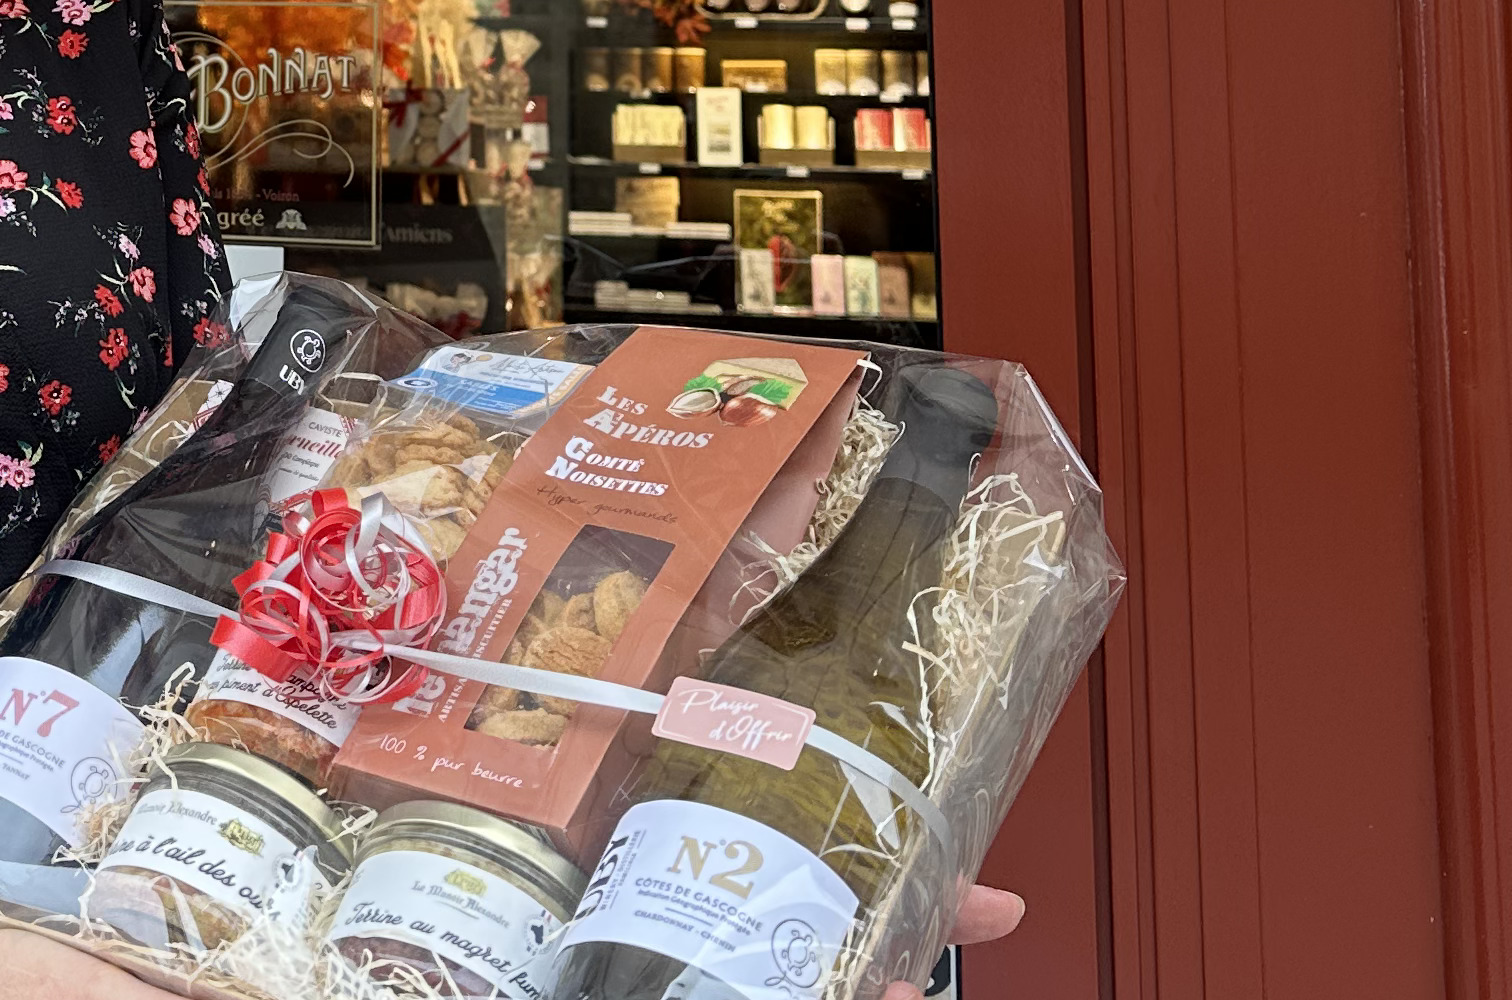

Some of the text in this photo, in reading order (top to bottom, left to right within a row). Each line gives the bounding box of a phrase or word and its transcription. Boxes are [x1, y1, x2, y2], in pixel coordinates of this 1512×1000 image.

[215, 207, 266, 229] gréé
[595, 385, 649, 415] LES
[308, 421, 344, 438] CAVISTE
[583, 408, 715, 449] APÉROS
[564, 435, 646, 473] COMTÉ
[544, 455, 670, 497] NOISETTES
[472, 598, 513, 660] ISCUITIER
[218, 677, 262, 694] piment
[677, 688, 759, 716] Plaisir
[11, 732, 67, 770] GASCOGNE
[378, 734, 523, 789] 100 % pur beurre
[198, 858, 236, 888] des
[411, 879, 424, 893] Le
[664, 834, 765, 901] N°2
[634, 875, 765, 933] CÔTES DE GASCOGNE
[344, 901, 404, 926] Terrine
[409, 919, 437, 935] au
[440, 929, 512, 974] magret
